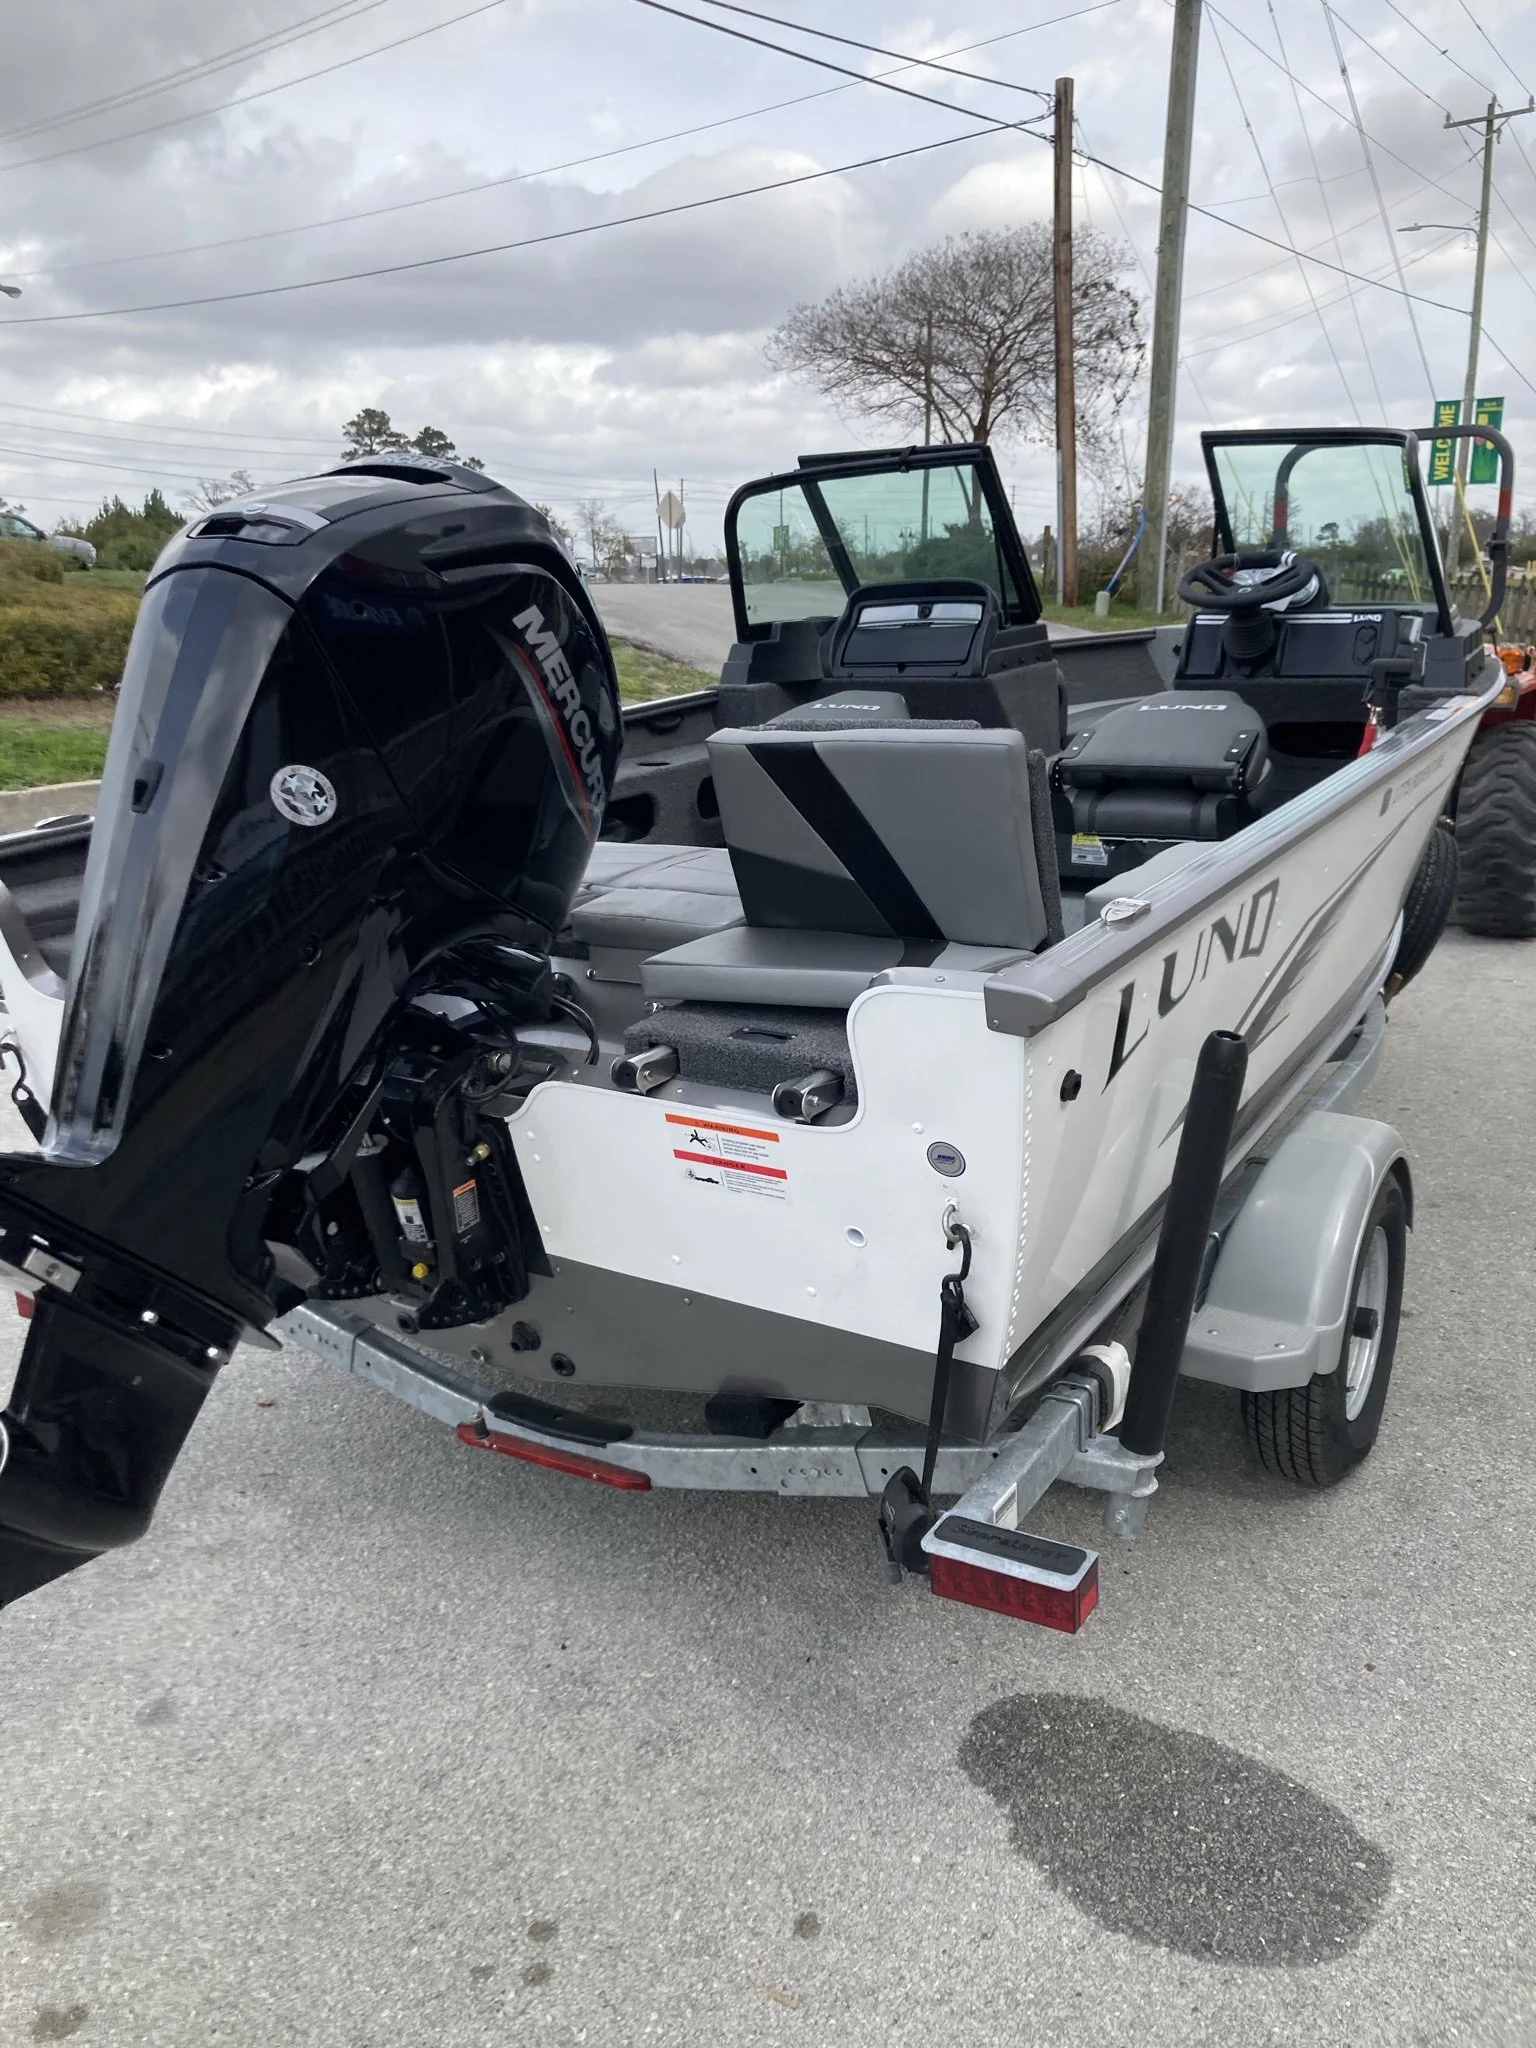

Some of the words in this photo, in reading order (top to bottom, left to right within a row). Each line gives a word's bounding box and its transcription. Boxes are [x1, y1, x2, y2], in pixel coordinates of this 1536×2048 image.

[1433, 404, 1456, 481] WELCME
[1353, 613, 1383, 623] LUND
[813, 702, 882, 712] LUND
[1138, 703, 1228, 712] LUND
[1101, 876, 1280, 1097] LUND
[703, 1122, 740, 1134] WARNING
[712, 1158, 746, 1170] DANGER
